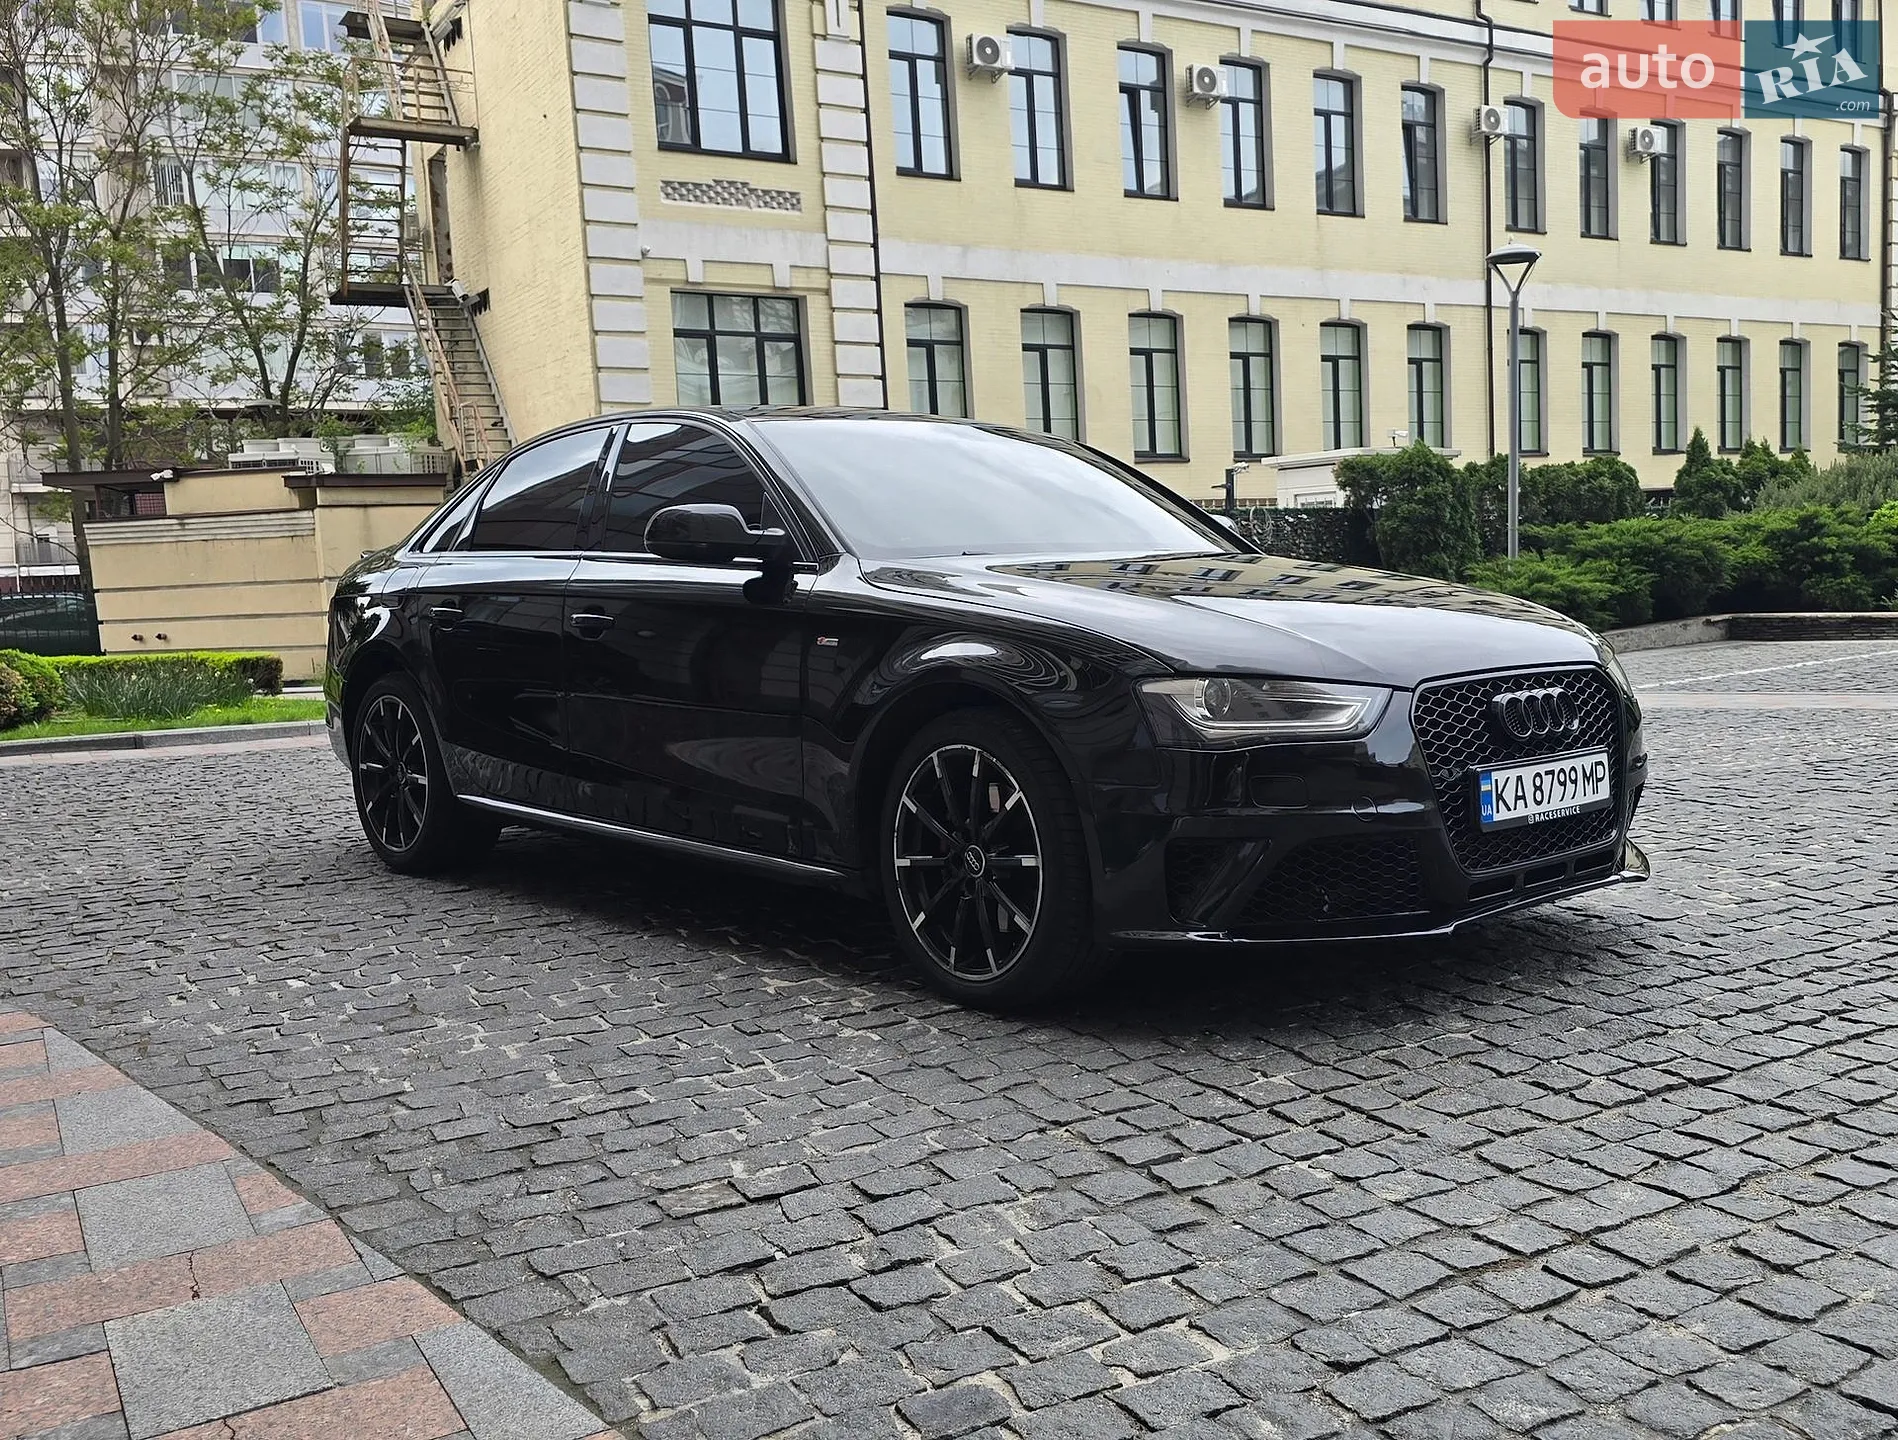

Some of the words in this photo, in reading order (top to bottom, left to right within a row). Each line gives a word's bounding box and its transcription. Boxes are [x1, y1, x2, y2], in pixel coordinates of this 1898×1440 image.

[1494, 775, 1528, 814] KA
[1532, 765, 1579, 806] 8799
[1581, 760, 1606, 797] MP
[1481, 804, 1493, 816] UA
